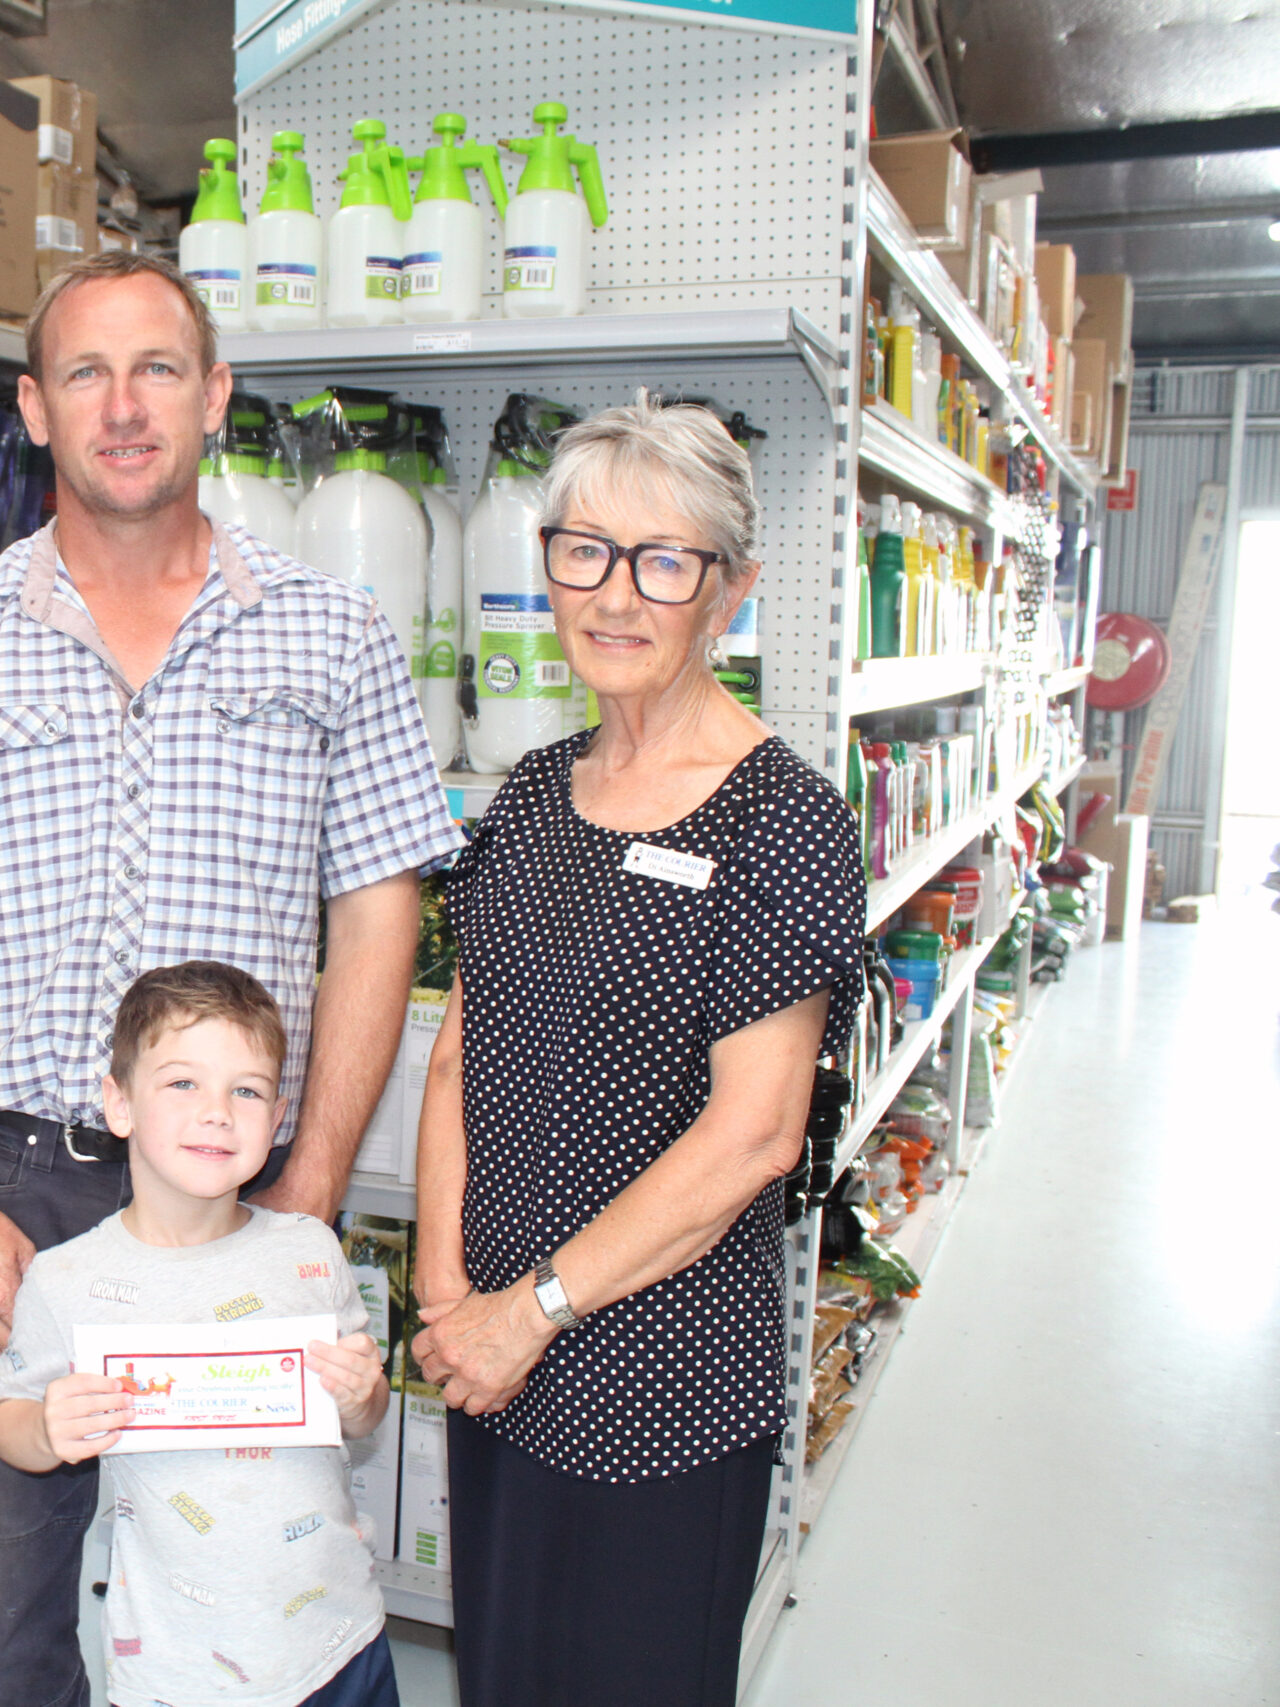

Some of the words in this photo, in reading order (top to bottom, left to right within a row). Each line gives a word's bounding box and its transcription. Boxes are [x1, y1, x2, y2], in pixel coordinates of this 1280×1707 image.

[276, 18, 304, 54] Hose
[304, 0, 347, 33] Fitting
[646, 850, 663, 861] THE
[411, 1010, 419, 1021] 8
[297, 1262, 331, 1279] THOR
[90, 1280, 118, 1300] IRON
[116, 1284, 141, 1305] MAN
[213, 1291, 257, 1315] DOCTOR
[216, 1298, 265, 1322] STRANGE
[201, 1362, 272, 1383] Sleigh
[177, 1398, 196, 1408] THE
[409, 1401, 418, 1412] 8
[224, 1447, 272, 1459] THOR
[168, 1495, 211, 1536] STRANGE
[177, 1491, 216, 1526] DOCTOR
